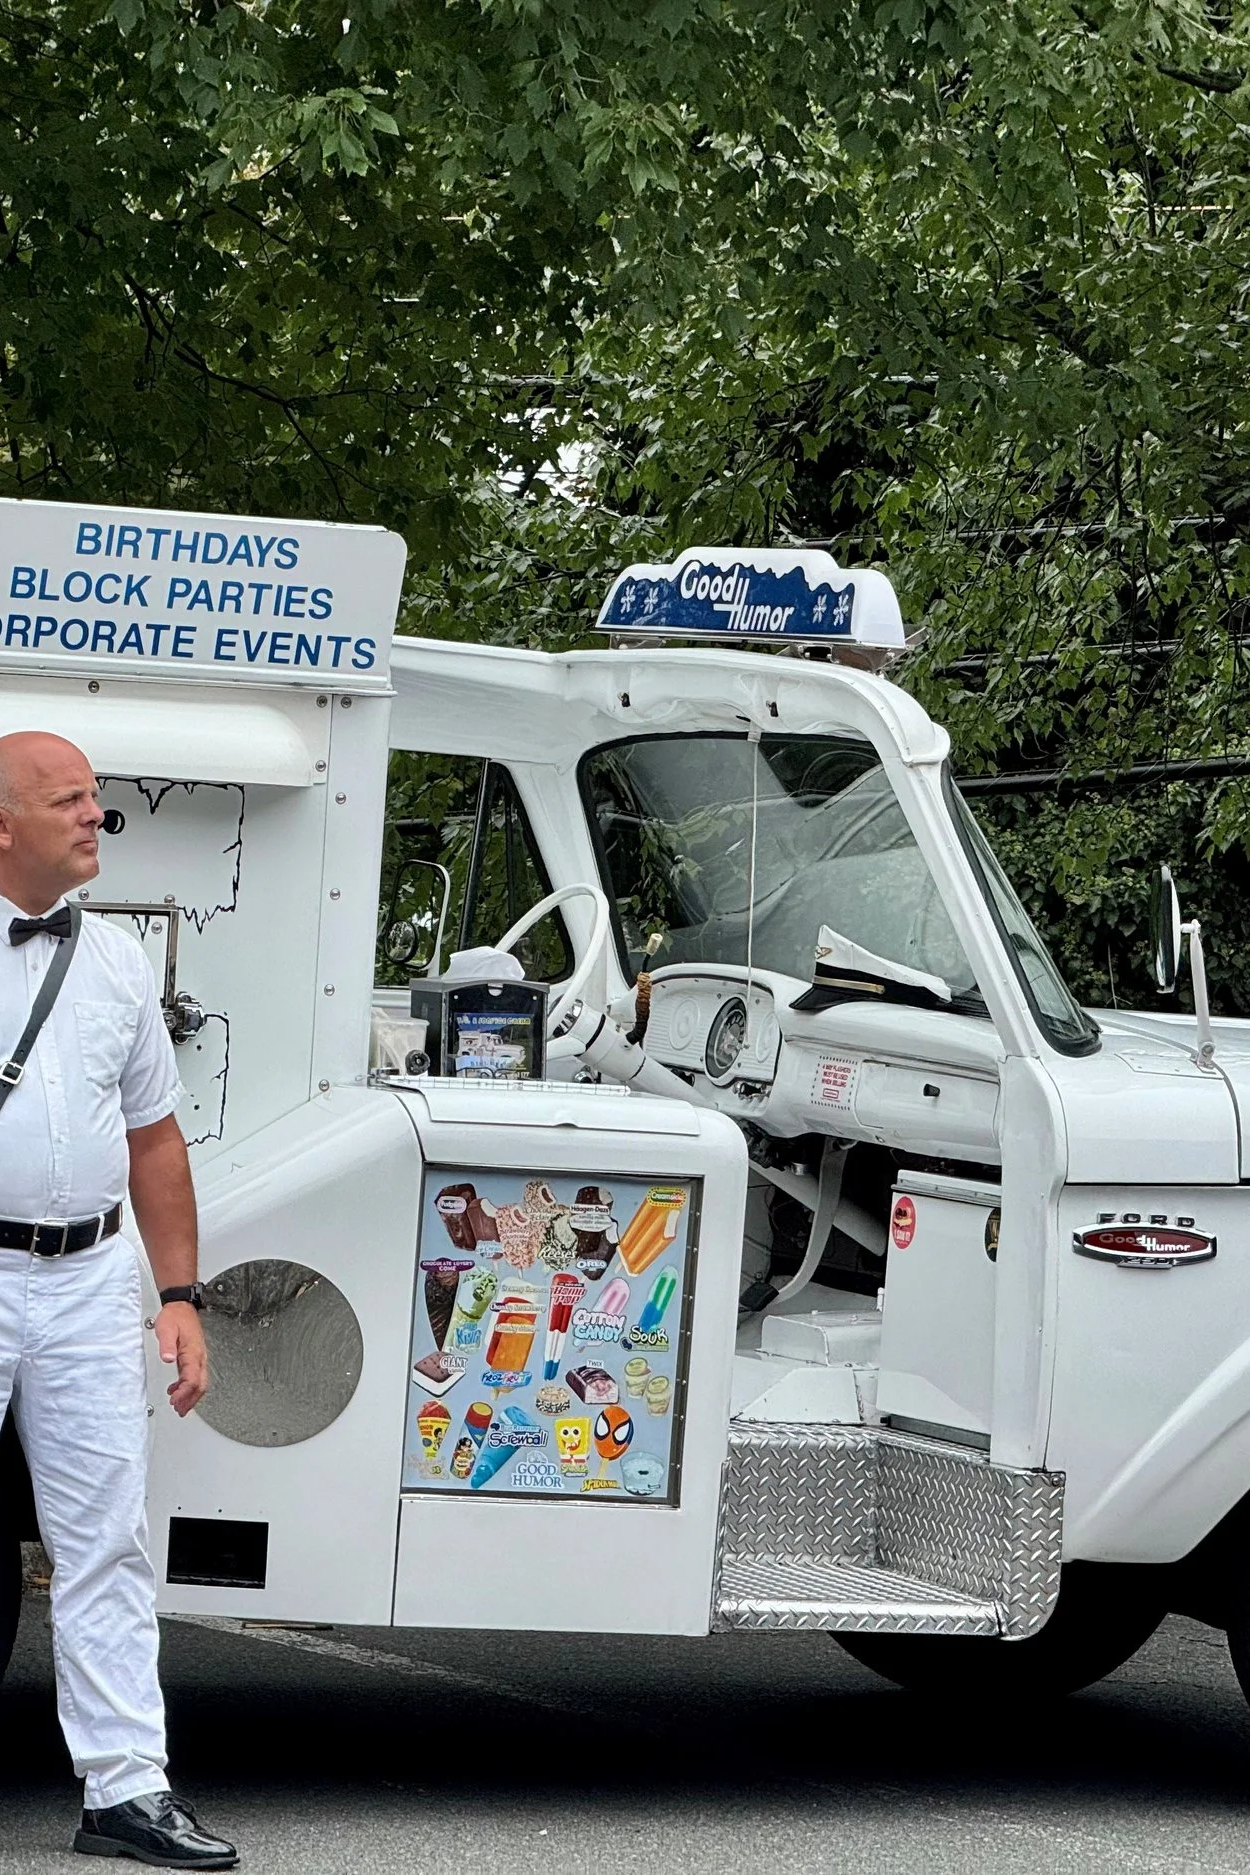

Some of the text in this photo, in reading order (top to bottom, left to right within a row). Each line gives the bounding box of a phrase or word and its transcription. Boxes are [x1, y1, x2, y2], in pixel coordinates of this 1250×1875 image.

[76, 522, 299, 570] BIRTHDAYS
[680, 561, 741, 601] Good
[9, 566, 333, 620] BLOCK PARTIES
[713, 576, 796, 632] Humor
[214, 628, 376, 669] EVENTS
[1097, 1212, 1195, 1228] FORD
[1099, 1233, 1146, 1247] Good
[1144, 1236, 1191, 1252] Humor
[572, 1308, 626, 1327] COTTON
[573, 1325, 624, 1343] CANDY
[440, 1356, 468, 1368] GIANT
[489, 1430, 548, 1447] Screwball
[517, 1463, 558, 1476] GOOD
[512, 1474, 562, 1488] HUMOR
